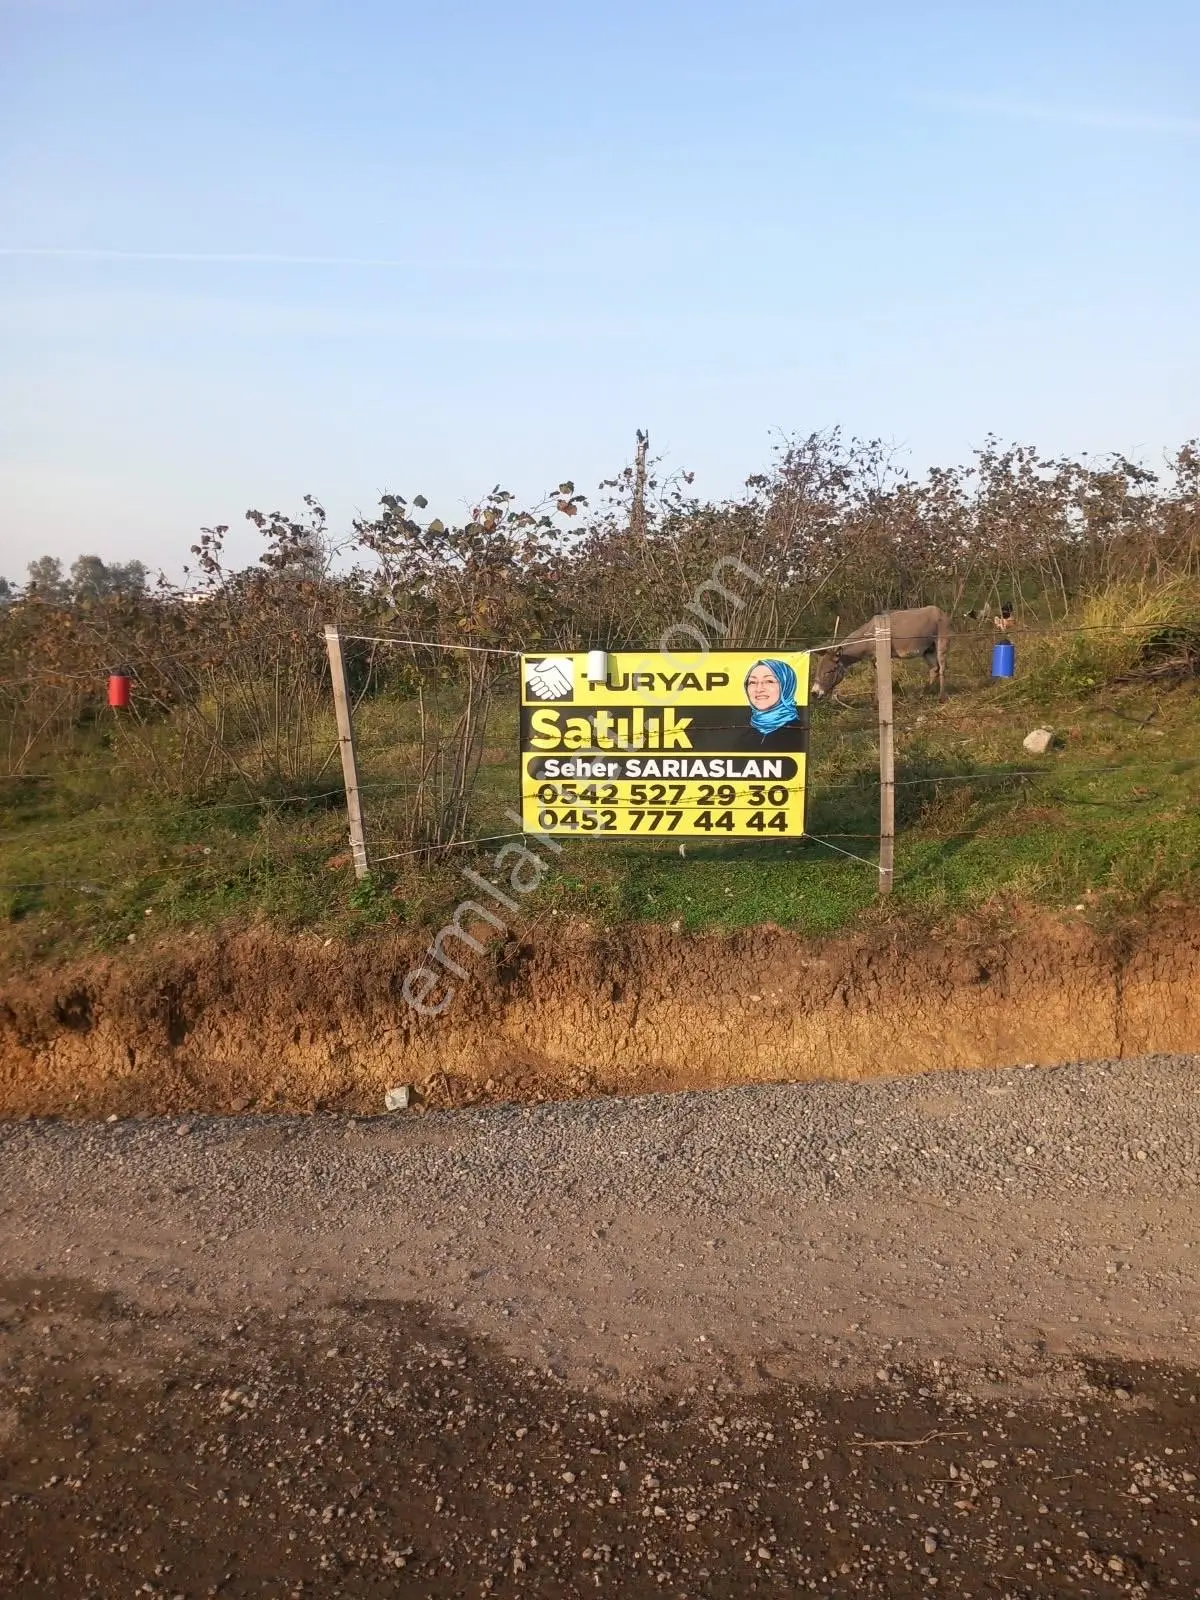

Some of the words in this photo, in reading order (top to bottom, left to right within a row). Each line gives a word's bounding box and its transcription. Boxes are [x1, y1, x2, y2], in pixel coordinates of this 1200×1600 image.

[530, 708, 693, 749] Satılık
[544, 759, 619, 778] Seher
[625, 759, 782, 778] SARIASLAN
[537, 784, 619, 805] 0542
[630, 784, 686, 805] 527
[697, 785, 736, 806] 29
[748, 785, 789, 806] 30
[538, 810, 617, 831] 0452
[629, 810, 683, 831] 777
[694, 811, 735, 831] 44
[746, 811, 788, 831] 44
